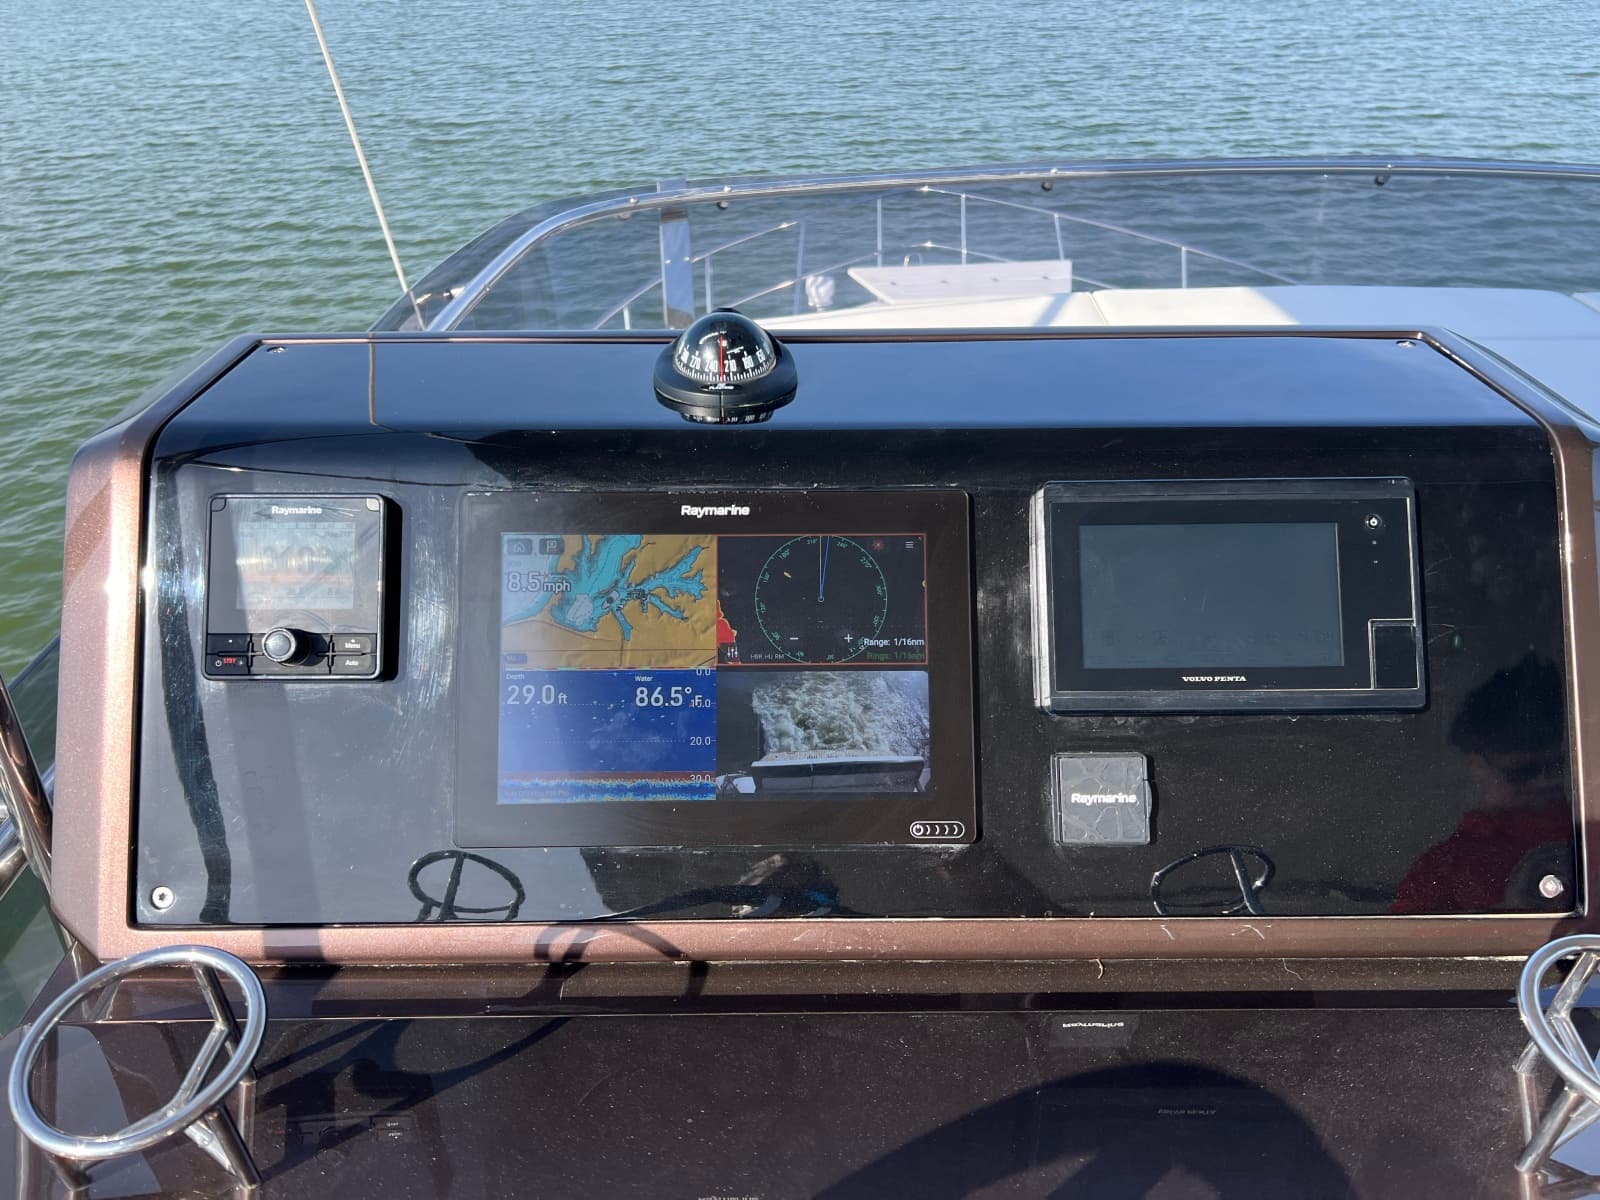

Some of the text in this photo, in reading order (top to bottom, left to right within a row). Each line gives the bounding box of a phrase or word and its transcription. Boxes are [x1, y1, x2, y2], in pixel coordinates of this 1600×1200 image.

[690, 355, 701, 370] 270
[705, 360, 718, 372] 240
[724, 360, 736, 372] 210
[271, 506, 322, 515] Raymarine
[681, 504, 750, 518] Raymarine
[508, 571, 571, 594] 8.5 mph
[864, 638, 890, 647] Range:
[894, 638, 924, 647] 1/16nm
[506, 673, 525, 681] Depth
[507, 684, 568, 705] 29.0 ft
[690, 737, 711, 745] 20.0
[1071, 793, 1138, 804] Raymarine
